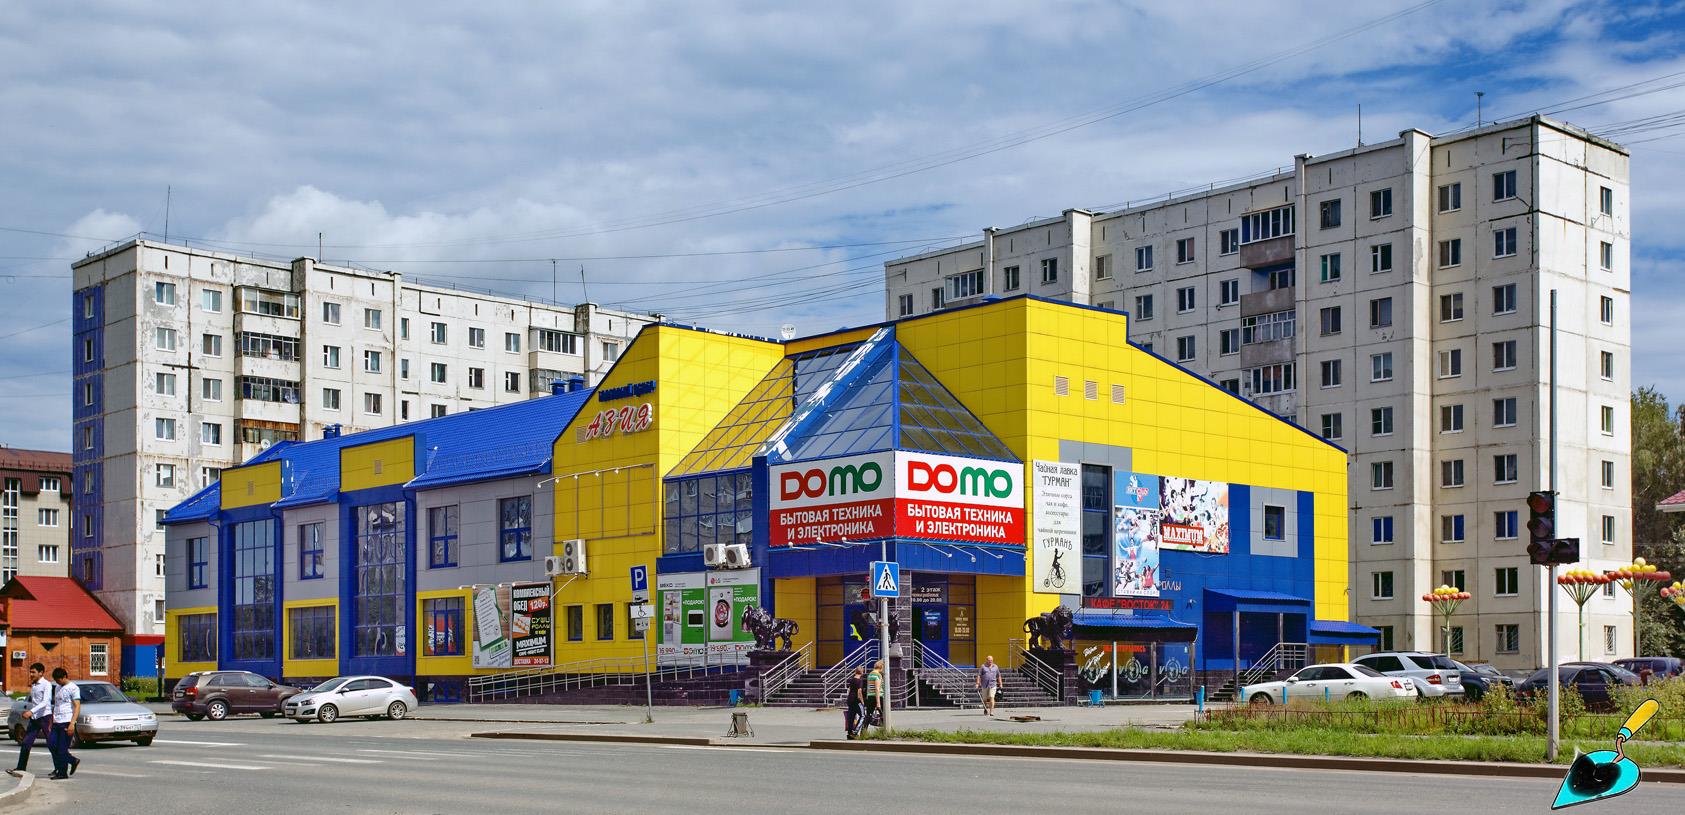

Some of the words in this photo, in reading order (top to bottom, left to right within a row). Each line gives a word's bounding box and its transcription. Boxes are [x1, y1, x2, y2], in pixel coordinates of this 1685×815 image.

[585, 403, 652, 440] АЗИЯ
[1035, 462, 1058, 474] Чайная
[1060, 467, 1078, 476] лавка
[780, 509, 830, 526] БЫТОВАЯ
[832, 503, 883, 521] ТЕХНИКА
[907, 503, 961, 520] БЫТОВАЯ
[963, 507, 1013, 524] ТЕХНИКА
[787, 528, 795, 541] И
[797, 520, 875, 540] ЭЛЕКТРОНИКА
[915, 520, 924, 533] И
[927, 521, 1006, 538] ЭЛЕКТРОНИКА
[1162, 525, 1204, 544] MAXIMUM
[634, 568, 644, 589] P
[513, 586, 550, 599] КОМПЛЕКСНЫЙ
[513, 600, 528, 612] ОБЕД
[1091, 598, 1115, 608] КАФЕ
[516, 636, 547, 650] MAXIMUM
